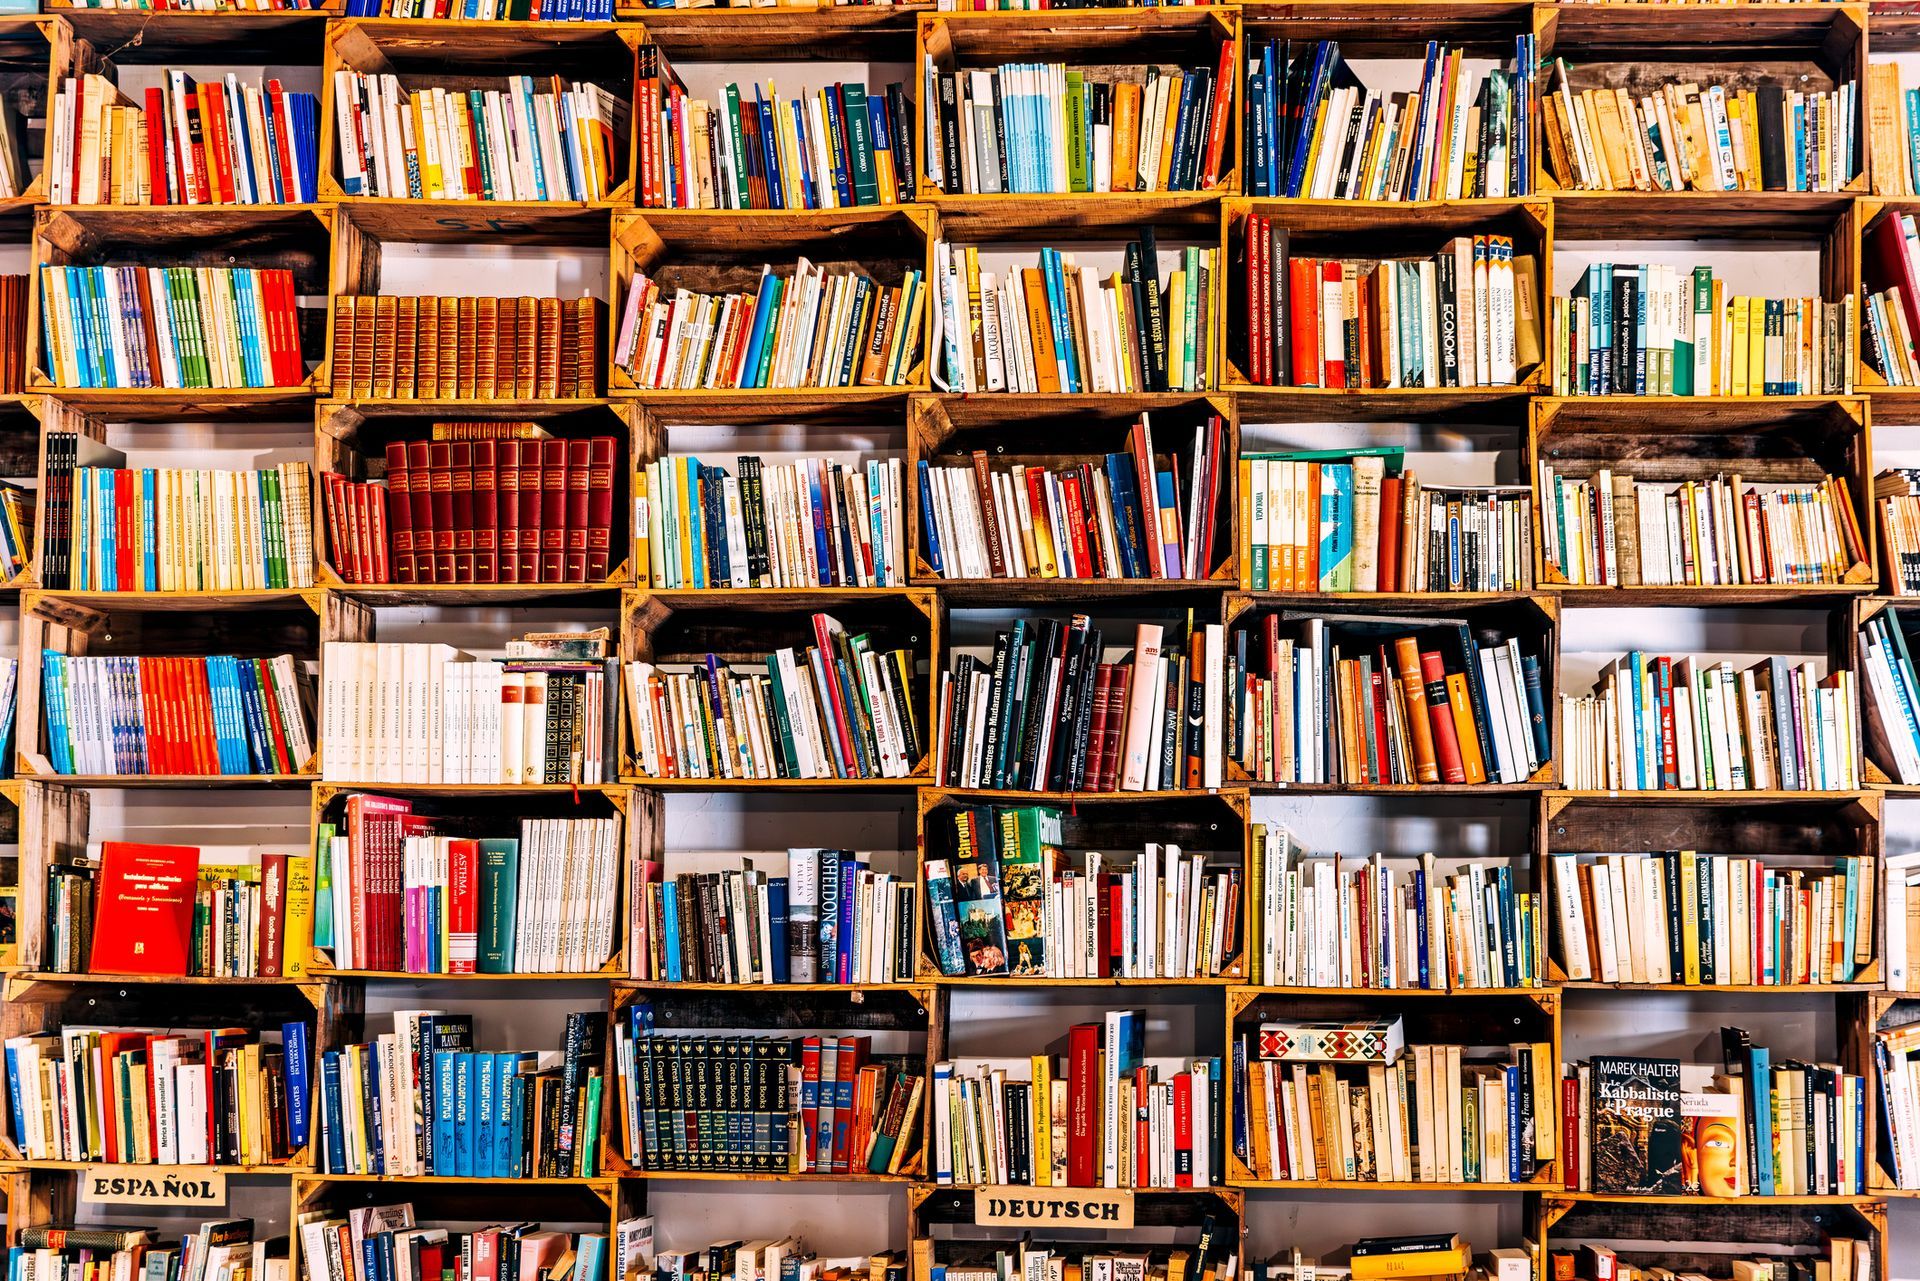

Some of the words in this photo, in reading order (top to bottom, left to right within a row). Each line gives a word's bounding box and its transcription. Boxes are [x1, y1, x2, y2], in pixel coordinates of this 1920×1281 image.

[643, 134, 649, 142] do
[854, 118, 863, 141] ESTRADA
[900, 125, 908, 145] Afectos
[857, 142, 864, 150] DA
[1256, 137, 1262, 145] DA
[858, 151, 867, 172] CÓDIGO
[903, 146, 911, 165] Raivas
[1129, 252, 1139, 268] Vitae
[1131, 269, 1141, 283] fons
[984, 288, 995, 312] LOEW
[1147, 279, 1158, 307] IMAGENS
[1622, 280, 1630, 317] psicologia
[878, 293, 889, 318] monde
[887, 302, 896, 322] 2001
[1150, 308, 1159, 317] DE
[876, 319, 884, 328] du
[1150, 318, 1161, 341] SÉCULO
[872, 329, 883, 350] l'état
[986, 324, 999, 361] JACQUES
[1443, 303, 1455, 367] ECONOMIA
[1621, 327, 1629, 365] introdução
[1154, 342, 1162, 353] UM
[1591, 353, 1599, 374] VOLUME
[799, 473, 807, 495] campos
[1068, 482, 1078, 509] vermelha
[1255, 491, 1263, 520] VIROLOGIA
[1072, 510, 1080, 524] tinta
[1125, 505, 1134, 524] social
[984, 499, 1001, 566] MACROECONOMICS
[1074, 525, 1081, 535] em
[1127, 525, 1137, 548] análise
[807, 547, 813, 555] de
[1076, 536, 1084, 553] Galiza
[808, 557, 816, 579] manual
[994, 650, 1005, 679] Mundo
[1883, 642, 1896, 665] Pedro
[1893, 673, 1909, 707] Cabrita
[1904, 712, 1916, 732] Reis
[871, 694, 880, 709] LOUP
[989, 686, 1001, 725] Mudaram
[1062, 684, 1071, 715] Sentimento
[1167, 710, 1176, 729] MAY
[876, 723, 885, 742] L'OURS
[988, 727, 998, 743] que
[1165, 730, 1175, 744] 14,
[1781, 721, 1789, 749] seigneurs
[982, 744, 994, 784] Desastres
[954, 811, 972, 859] Chronik
[1001, 812, 1014, 859] Chronik
[457, 853, 467, 895] ASTHMA
[1699, 861, 1708, 903] D'ORMESSON
[821, 858, 837, 921] SHELDON
[352, 896, 361, 932] CLOCKS
[1087, 906, 1095, 929] double
[1701, 907, 1709, 920] Jean
[267, 916, 275, 938] Goodbye
[1087, 930, 1095, 957] méprise
[397, 1033, 405, 1053] image
[398, 1055, 406, 1089] impossible
[641, 1060, 650, 1081] Great
[670, 1061, 679, 1082] Great
[697, 1061, 706, 1082] Great
[729, 1062, 737, 1083] Great
[1600, 1061, 1637, 1076] MAREK
[1639, 1063, 1679, 1077] HALTER
[643, 1083, 652, 1105] Books
[1599, 1083, 1679, 1101] Kabbaliste
[1611, 1079, 1621, 1087] Le
[292, 1085, 301, 1109] GATES
[671, 1083, 680, 1106] Books
[699, 1084, 707, 1107] Books
[729, 1085, 738, 1107] Books
[1521, 1092, 1529, 1115] France
[1521, 1116, 1529, 1124] de
[1605, 1100, 1615, 1109] de
[1615, 1099, 1674, 1122] Prague
[94, 1174, 216, 1199] ESPAÑOL
[988, 1199, 1120, 1221] DEUTSCH
